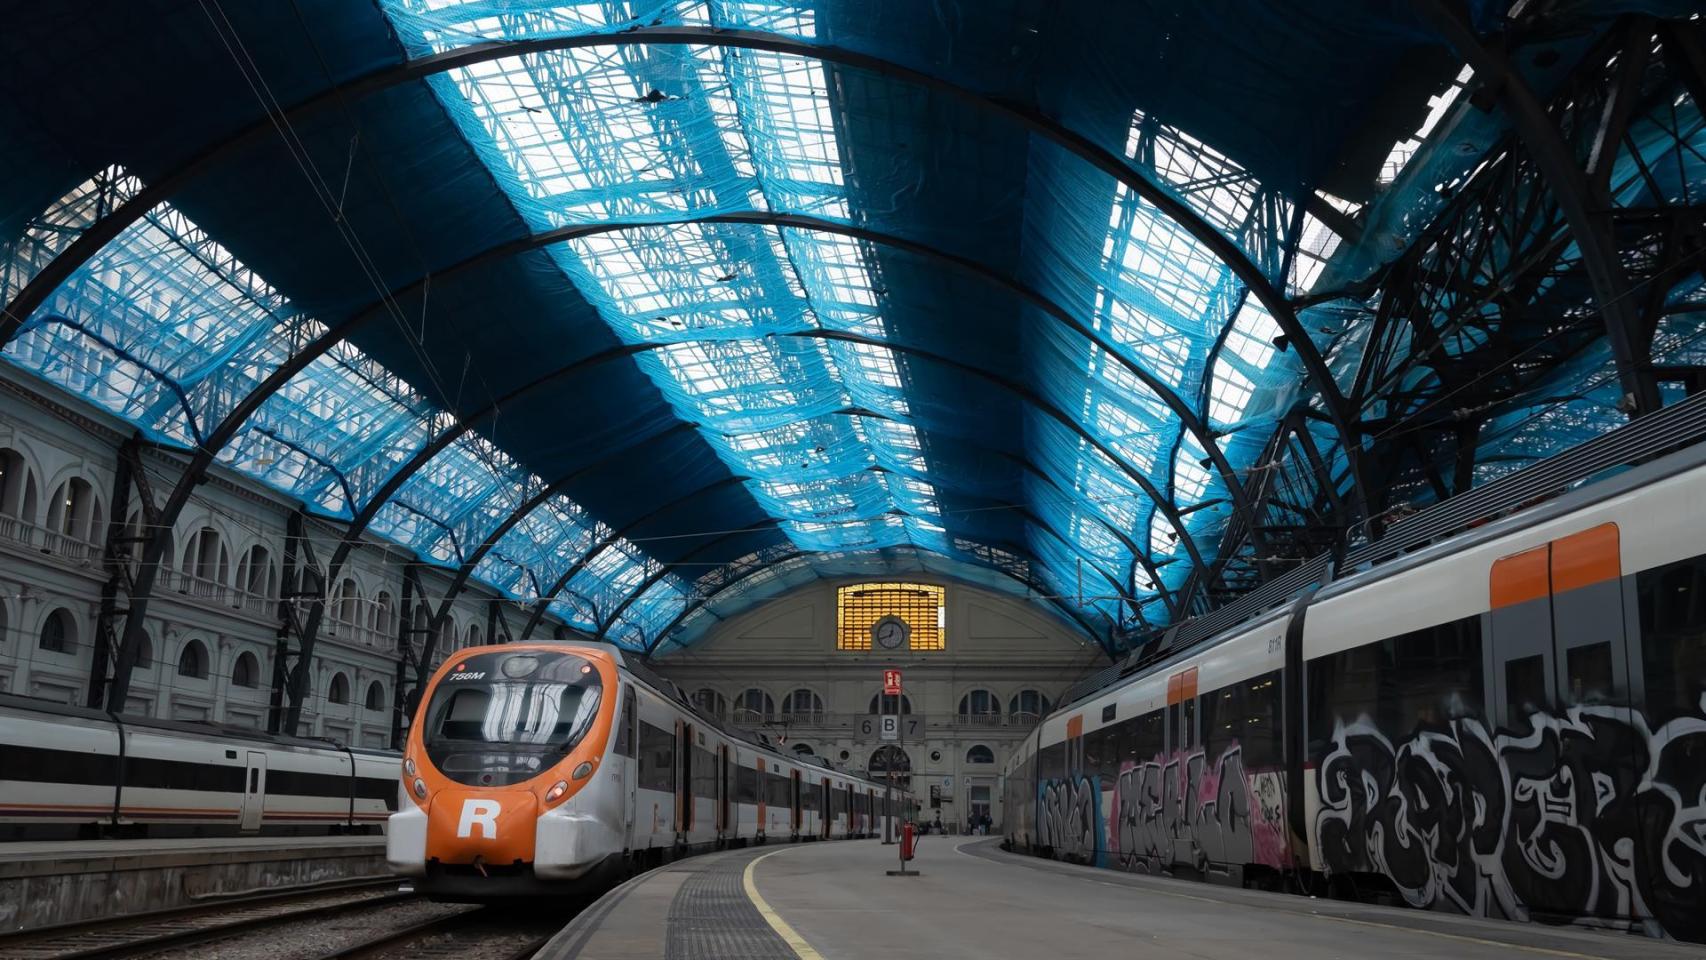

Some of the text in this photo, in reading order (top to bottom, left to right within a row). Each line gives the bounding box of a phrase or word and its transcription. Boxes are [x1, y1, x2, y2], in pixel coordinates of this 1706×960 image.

[449, 671, 487, 681] 756M
[862, 720, 872, 734] 6
[884, 718, 895, 731] B
[908, 720, 918, 735] 7
[456, 799, 502, 840] R
